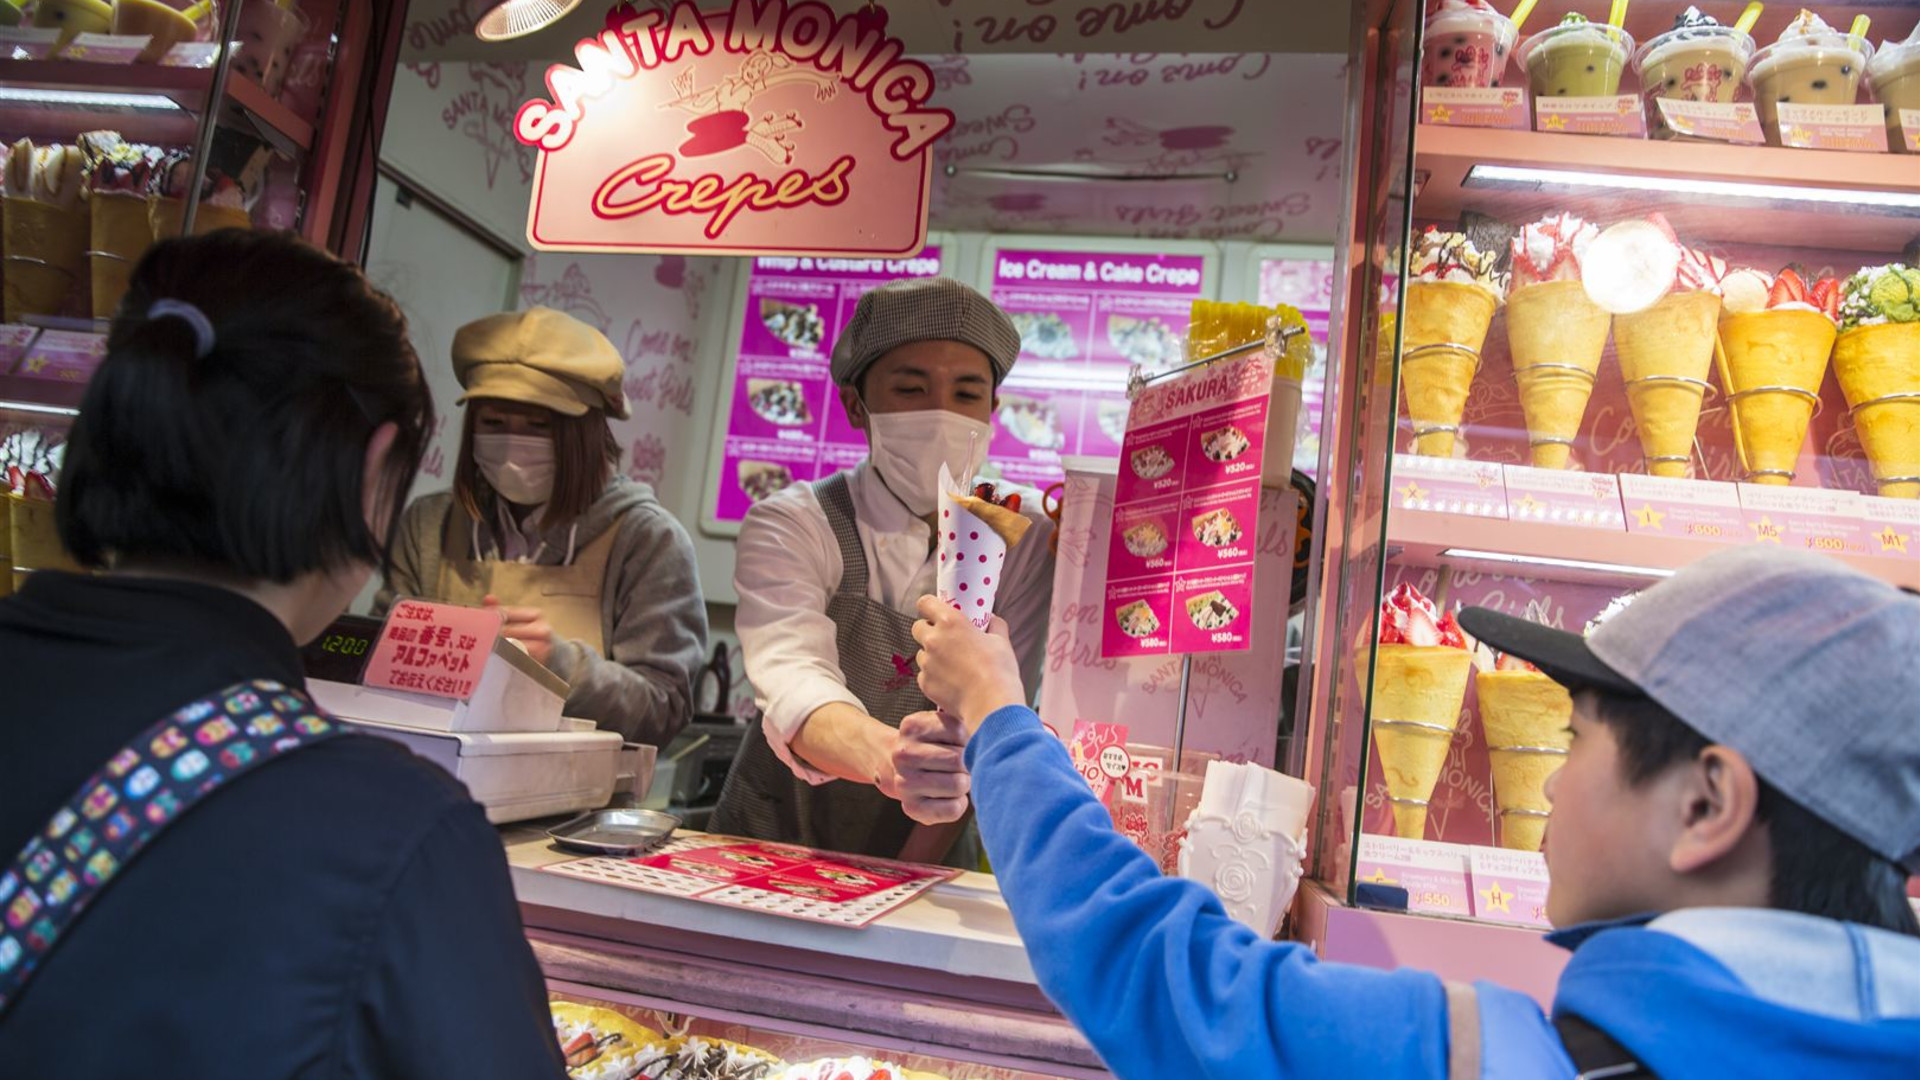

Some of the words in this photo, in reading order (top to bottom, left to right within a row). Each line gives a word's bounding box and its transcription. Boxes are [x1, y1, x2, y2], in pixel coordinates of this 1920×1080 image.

[515, 6, 714, 151] SANTA
[726, 0, 955, 161] MONICA
[592, 153, 856, 240] Crepes
[999, 258, 1025, 278] Ice
[1025, 259, 1082, 281] Cream
[1083, 261, 1098, 281] &
[1100, 262, 1144, 284] Cake
[1146, 264, 1200, 287] Crepe
[1165, 375, 1230, 410] SAKURA
[1758, 523, 1777, 537] M5
[1881, 533, 1901, 546] M1
[1211, 632, 1232, 643] ¥580
[391, 645, 470, 674] アルファベット
[1126, 776, 1143, 798] M
[1491, 891, 1502, 905] H
